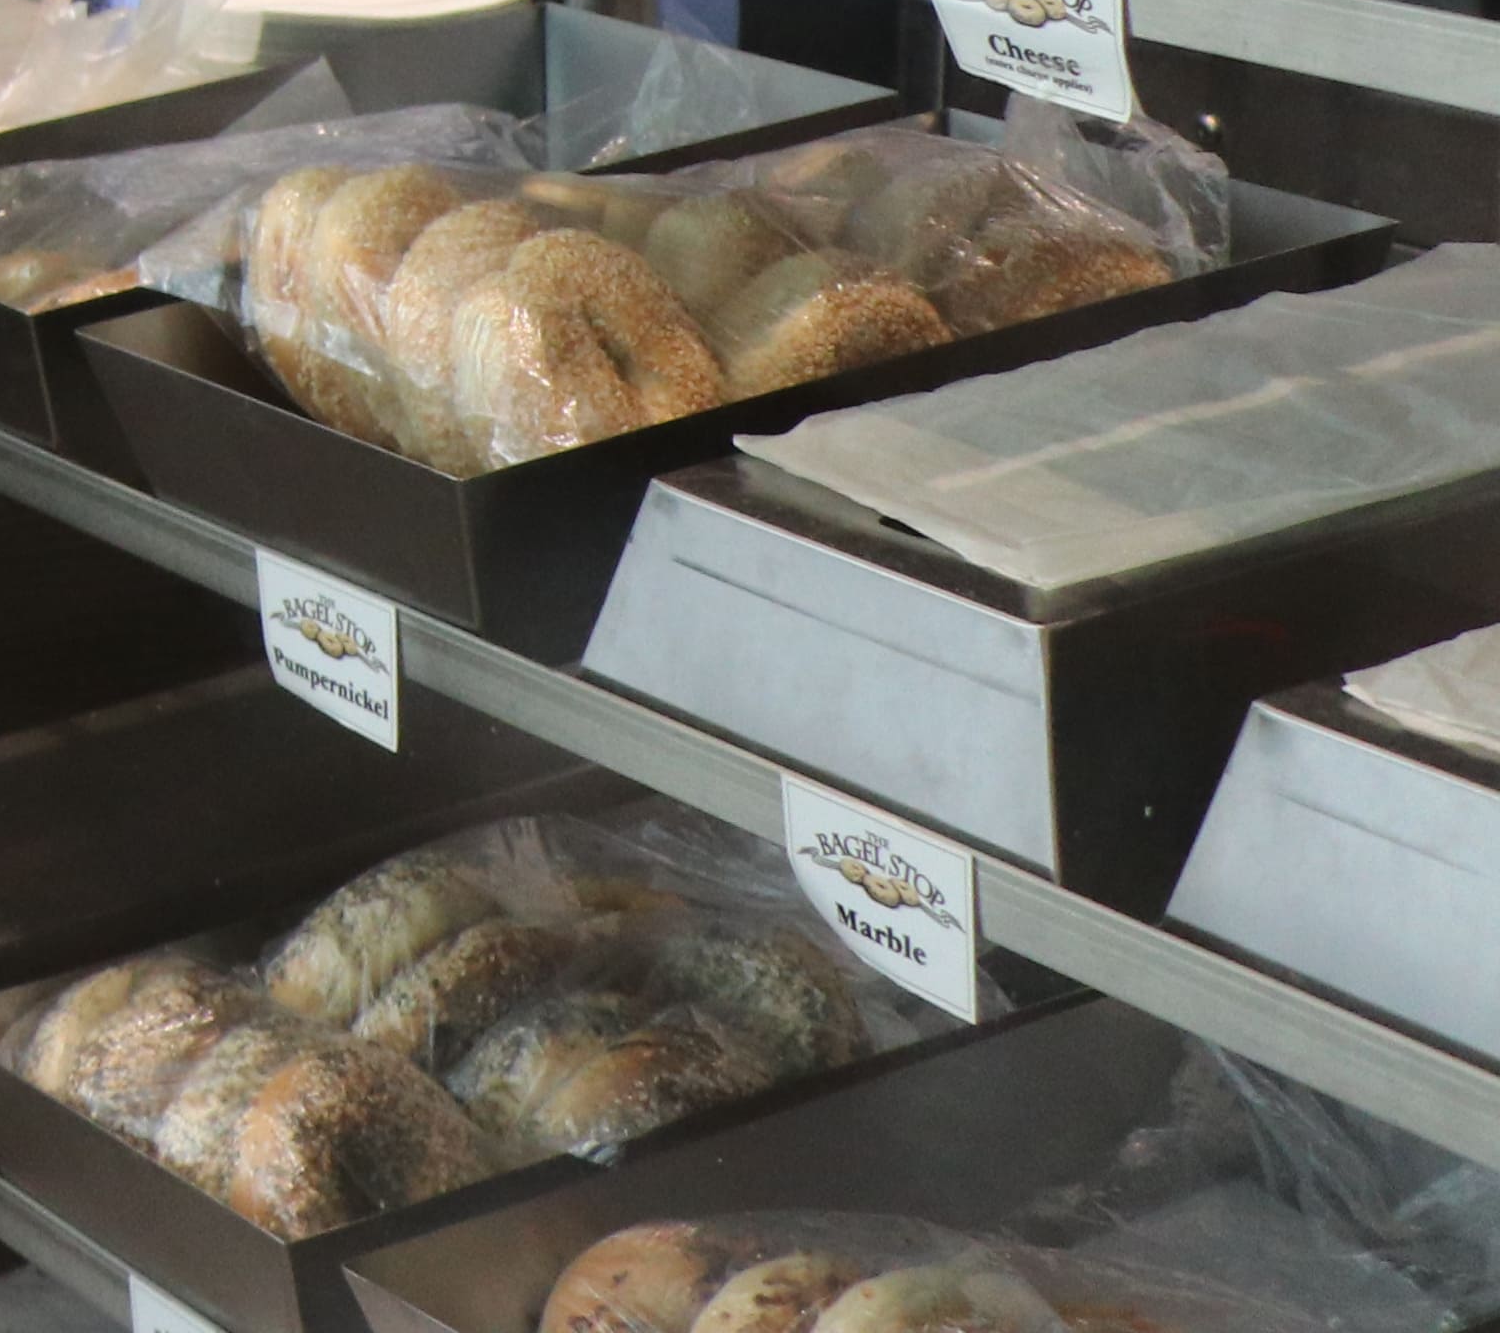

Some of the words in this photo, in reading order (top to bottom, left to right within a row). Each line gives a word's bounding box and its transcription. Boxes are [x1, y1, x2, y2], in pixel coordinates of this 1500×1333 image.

[987, 33, 1082, 77] Cheese
[283, 597, 334, 627] BAGEL
[335, 612, 376, 655] STOP
[273, 645, 389, 721] Pumpernickel
[815, 832, 887, 870] BAGEL
[889, 854, 946, 907] STOP
[835, 901, 928, 966] Marble
